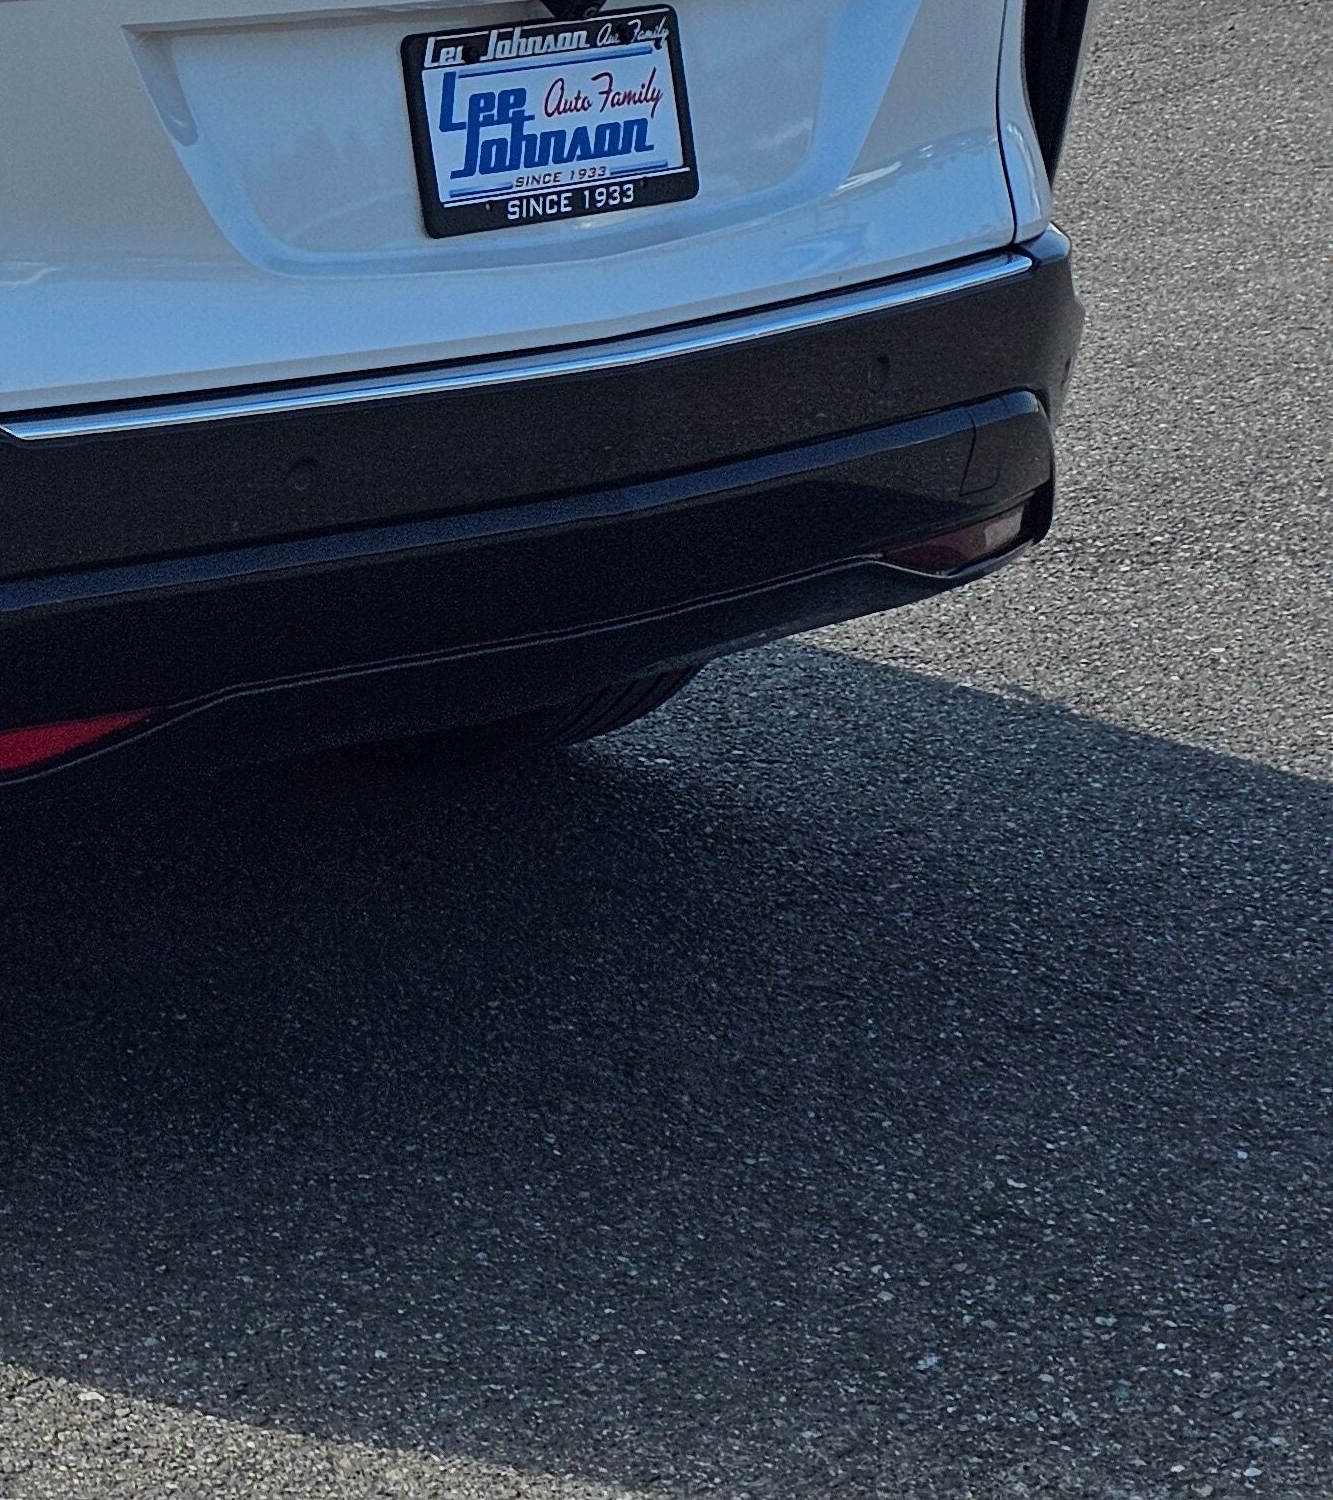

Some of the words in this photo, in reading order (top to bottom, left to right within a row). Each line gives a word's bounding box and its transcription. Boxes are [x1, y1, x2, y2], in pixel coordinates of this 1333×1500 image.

[479, 26, 590, 62] Johnson
[627, 15, 670, 47] Family
[439, 71, 535, 132] Lee
[544, 77, 593, 118] Auto
[591, 66, 664, 119] Family
[450, 109, 655, 180] Johnson
[515, 174, 563, 188] SINCE
[569, 166, 608, 182] 1933
[507, 192, 573, 220] SINCE
[582, 183, 635, 210] 1933
